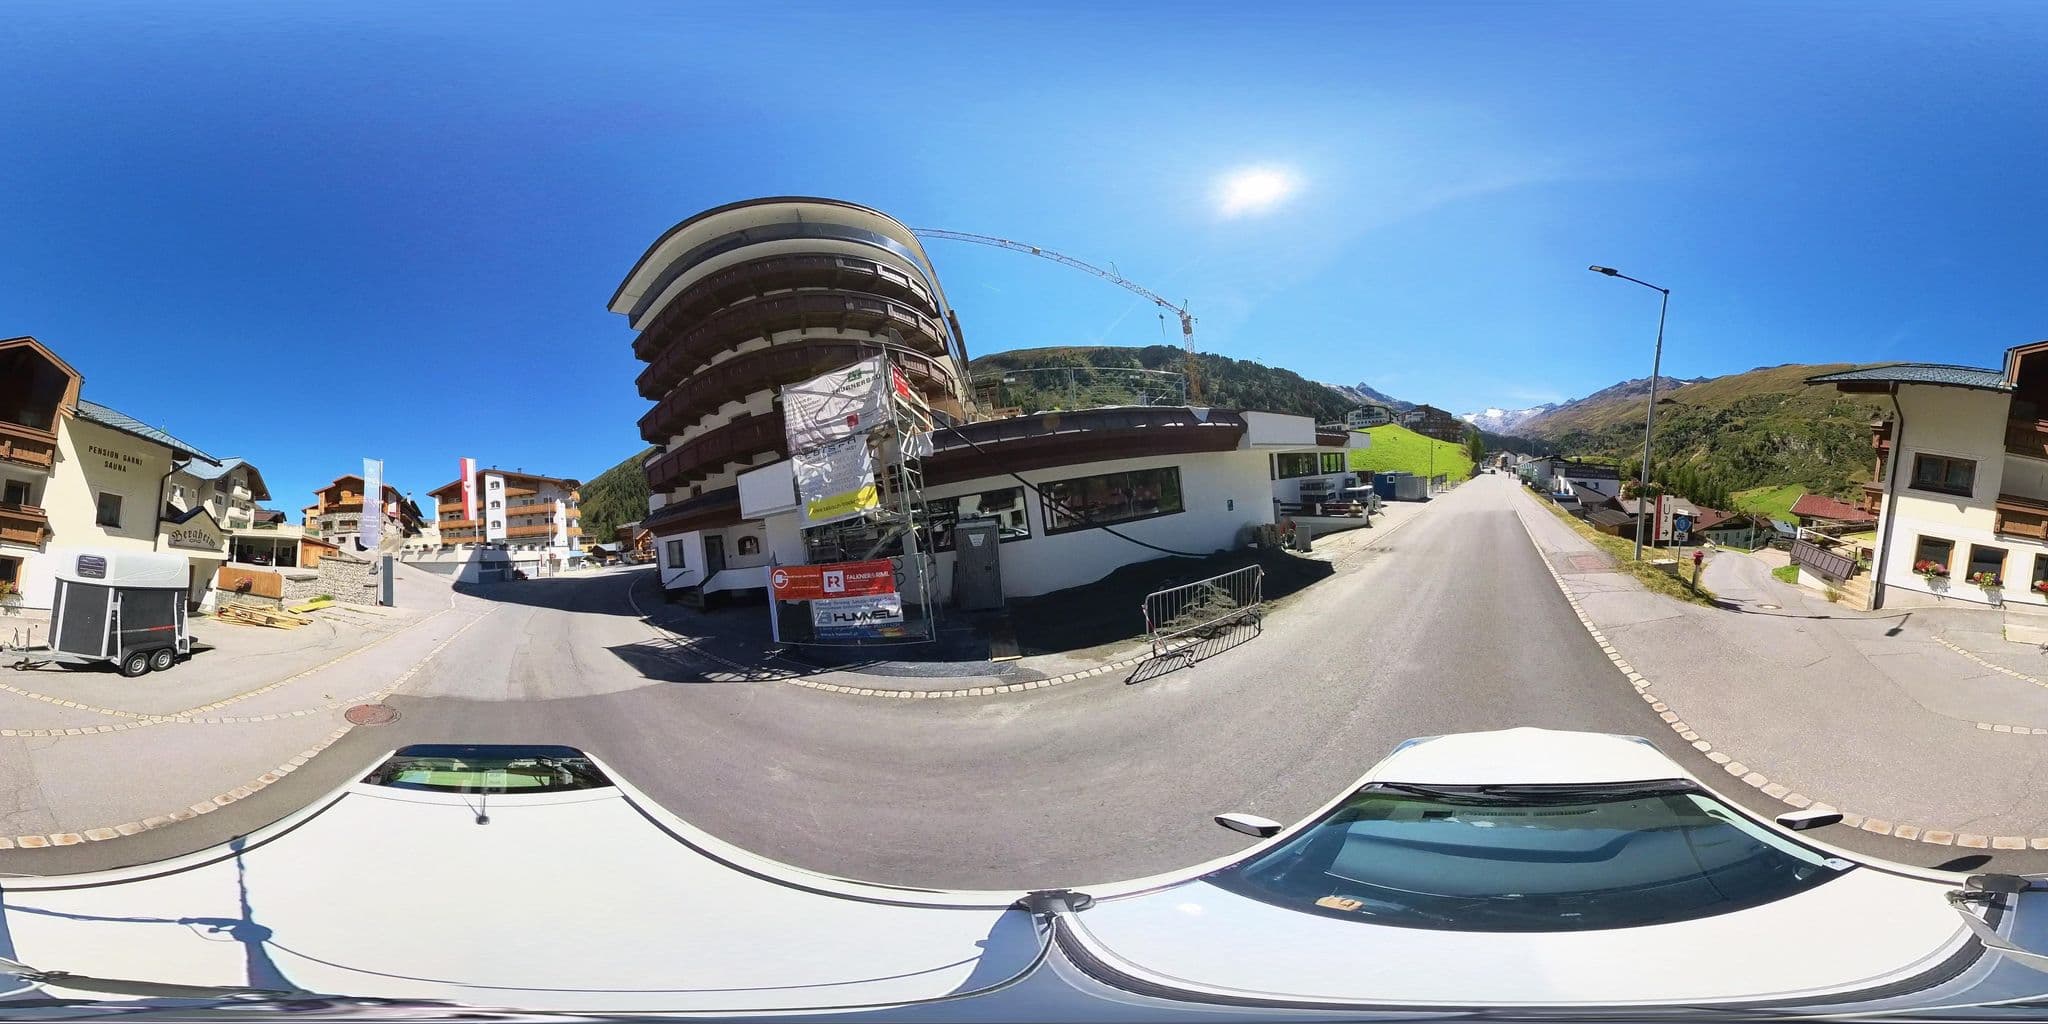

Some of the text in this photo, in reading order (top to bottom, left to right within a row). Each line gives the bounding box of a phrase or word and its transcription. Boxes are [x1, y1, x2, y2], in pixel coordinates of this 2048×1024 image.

[88, 445, 119, 459] PENSION
[104, 461, 127, 473] SAUNA
[171, 528, 216, 548] Bergheim
[833, 608, 899, 622] HUMMEL
